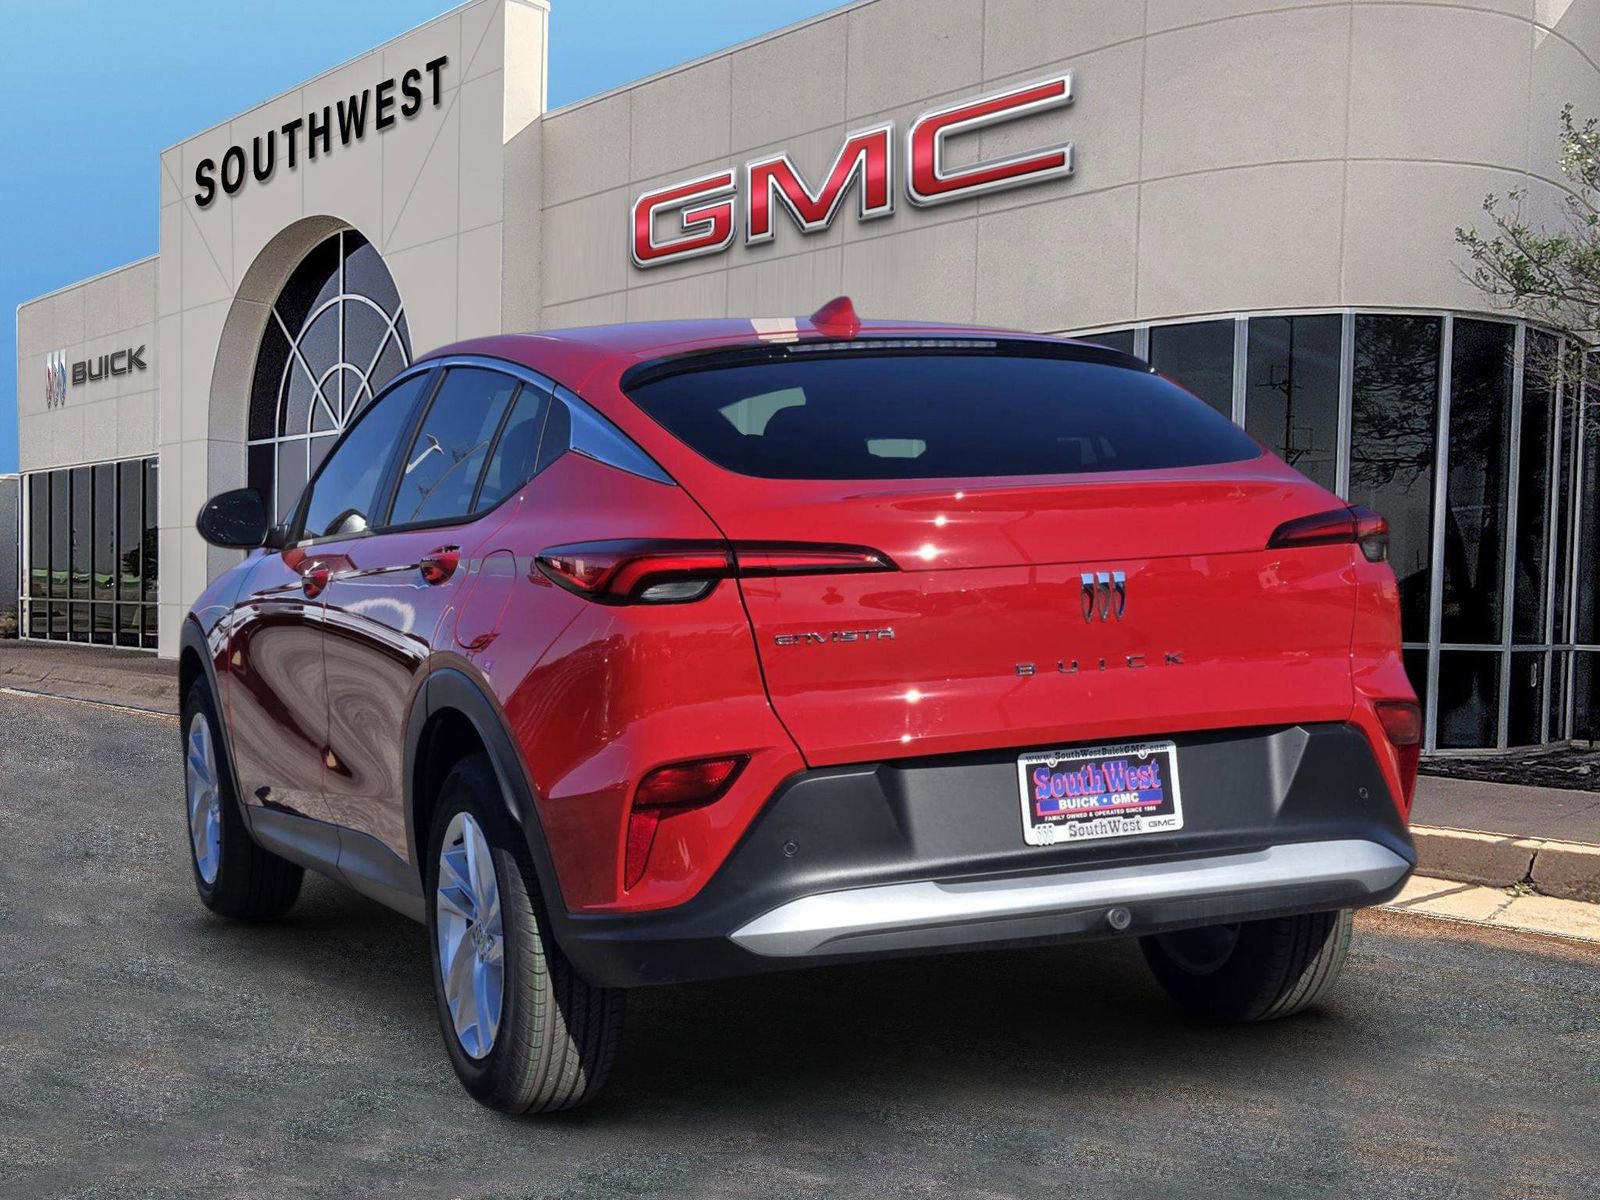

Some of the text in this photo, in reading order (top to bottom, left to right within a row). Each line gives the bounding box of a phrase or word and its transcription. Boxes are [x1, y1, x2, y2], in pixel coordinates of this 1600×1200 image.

[194, 55, 449, 207] SOUTHWEST
[630, 68, 1076, 270] GMC
[72, 344, 147, 386] BUICK
[774, 626, 896, 646] ENVISTA
[1015, 651, 1185, 677] BUICK
[1058, 792, 1140, 811] BUICK GMC
[1044, 814, 1066, 822] FAMILY
[1066, 812, 1088, 820] OWNED
[1094, 808, 1125, 817] OPERATED
[1125, 806, 1143, 814] SINCE
[1148, 818, 1177, 829] GMC
